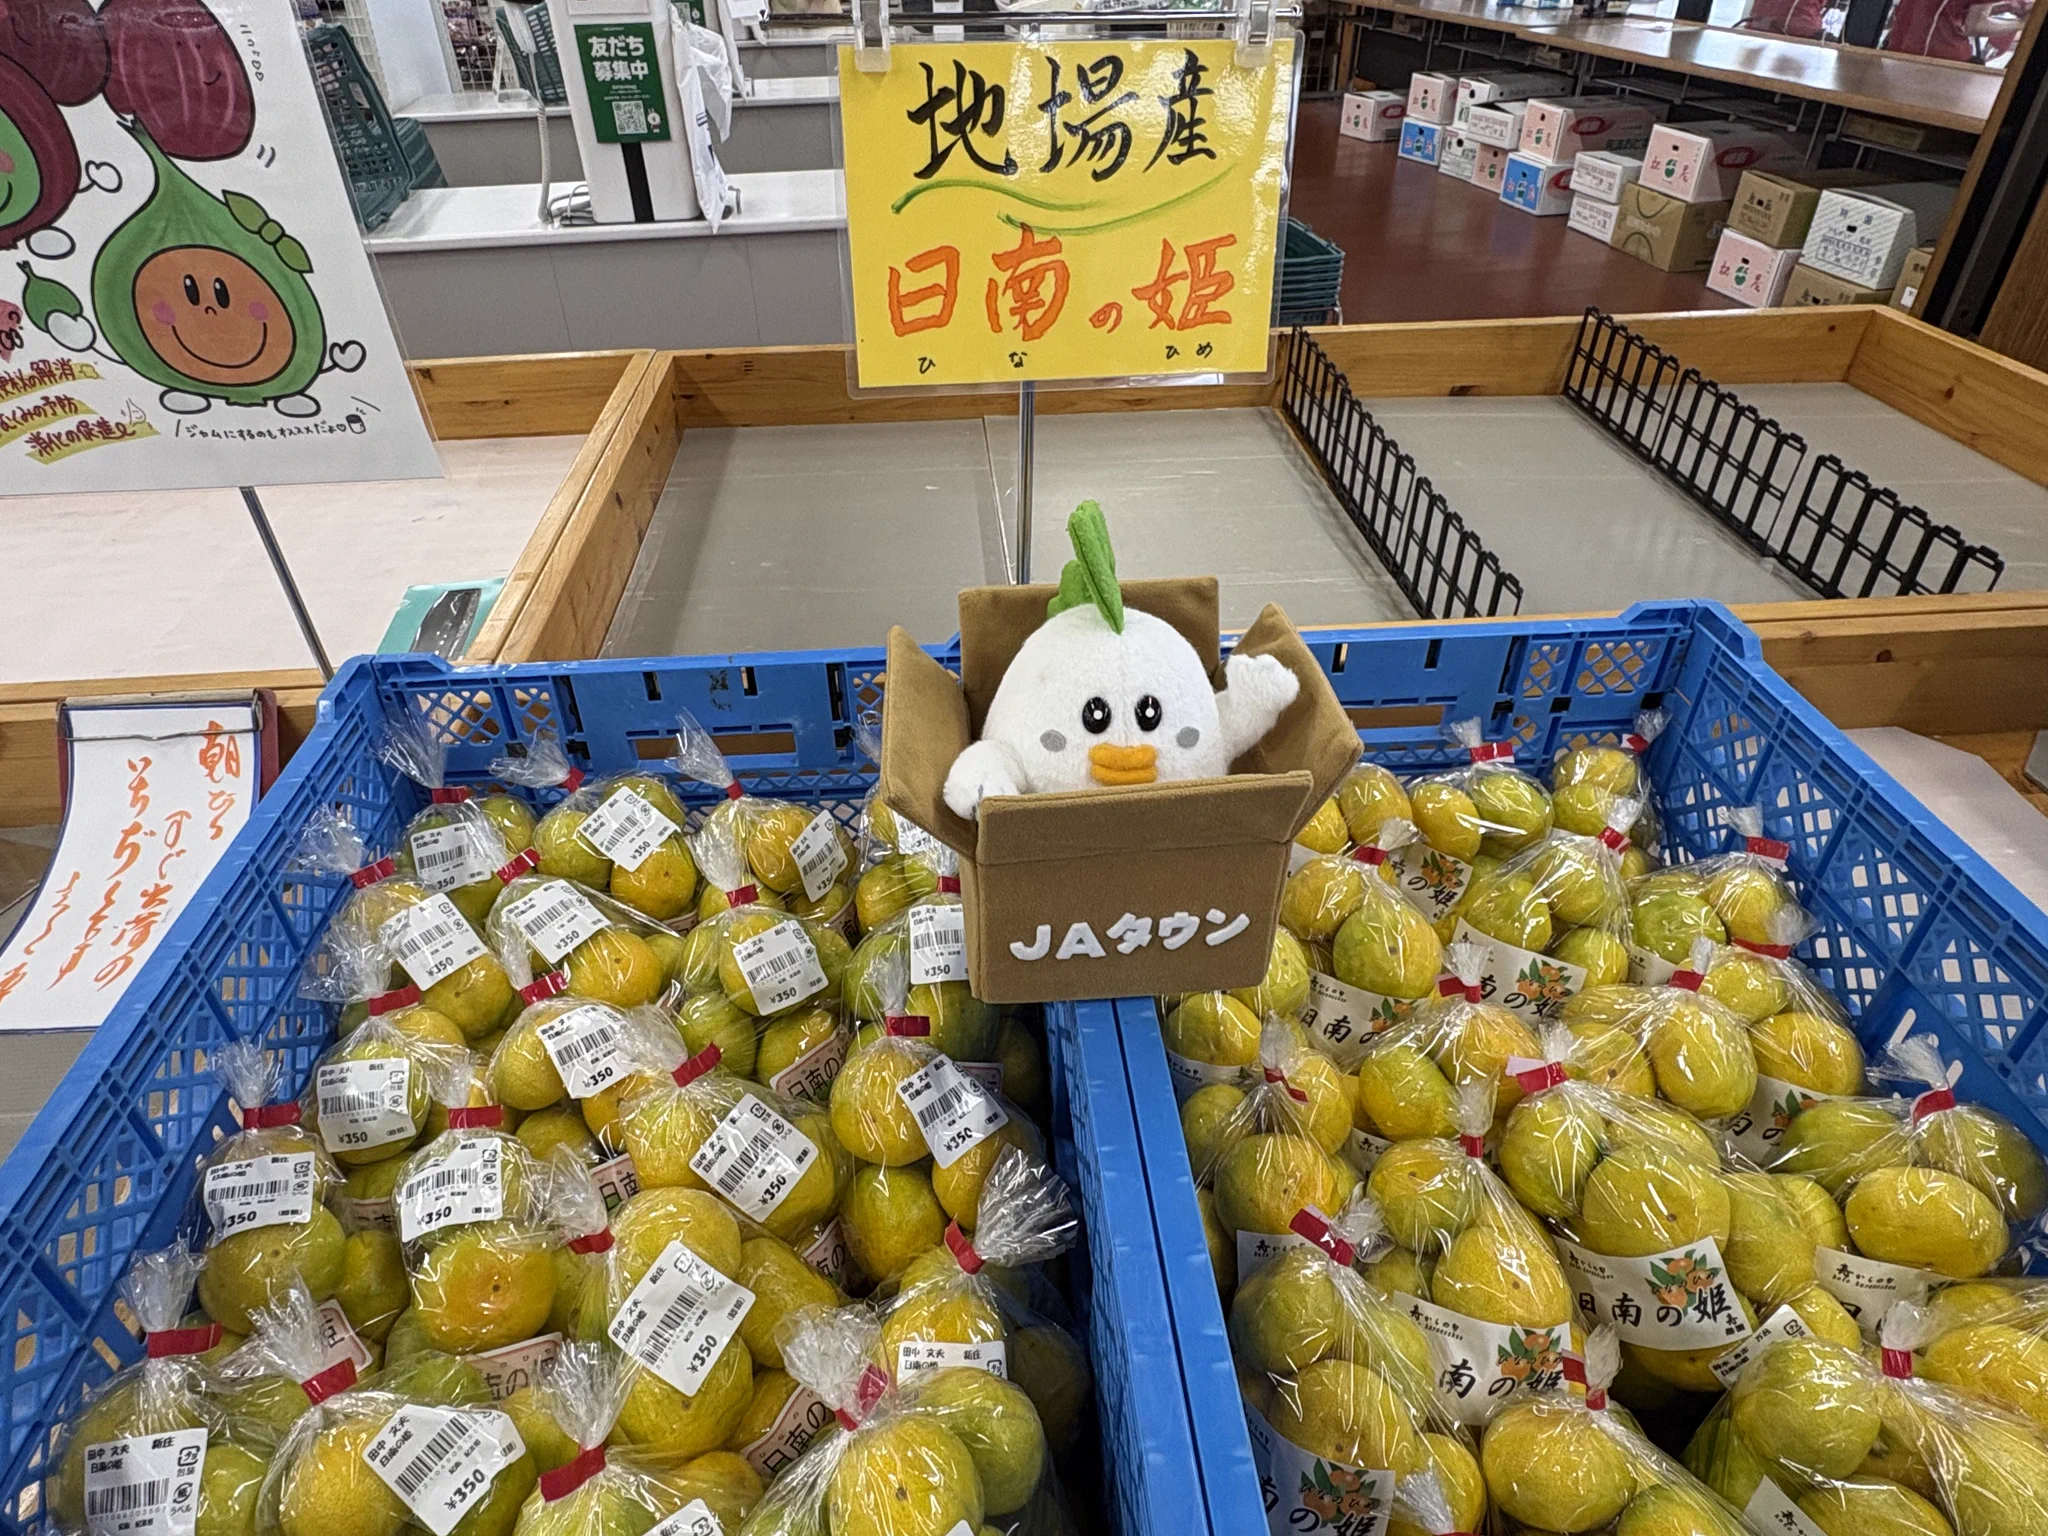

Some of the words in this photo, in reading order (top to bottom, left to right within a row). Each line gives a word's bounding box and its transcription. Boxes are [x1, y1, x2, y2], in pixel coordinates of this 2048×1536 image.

[588, 35, 645, 57] 友だち
[593, 60, 649, 81] 募集中
[907, 47, 1217, 182] 地場産
[888, 223, 1238, 341] 日南の姫
[554, 930, 580, 949] ¥350
[1009, 908, 1250, 961] JAタウン
[924, 964, 950, 977] ¥350
[769, 987, 797, 1004] ¥350
[582, 1066, 614, 1088] ¥350
[338, 1131, 368, 1144] ¥350
[943, 1127, 974, 1152] ¥350
[758, 1173, 787, 1206] ¥350
[1579, 1283, 1732, 1327] 日南の姫
[611, 1319, 626, 1340] 田中
[686, 1334, 718, 1374] ¥350
[903, 1346, 920, 1358] 田中
[926, 1348, 945, 1359] 文夫
[367, 1439, 387, 1463] 田中
[389, 1415, 411, 1438] 文夫
[379, 1429, 414, 1468] 日南の姫
[443, 1468, 486, 1511] ¥350
